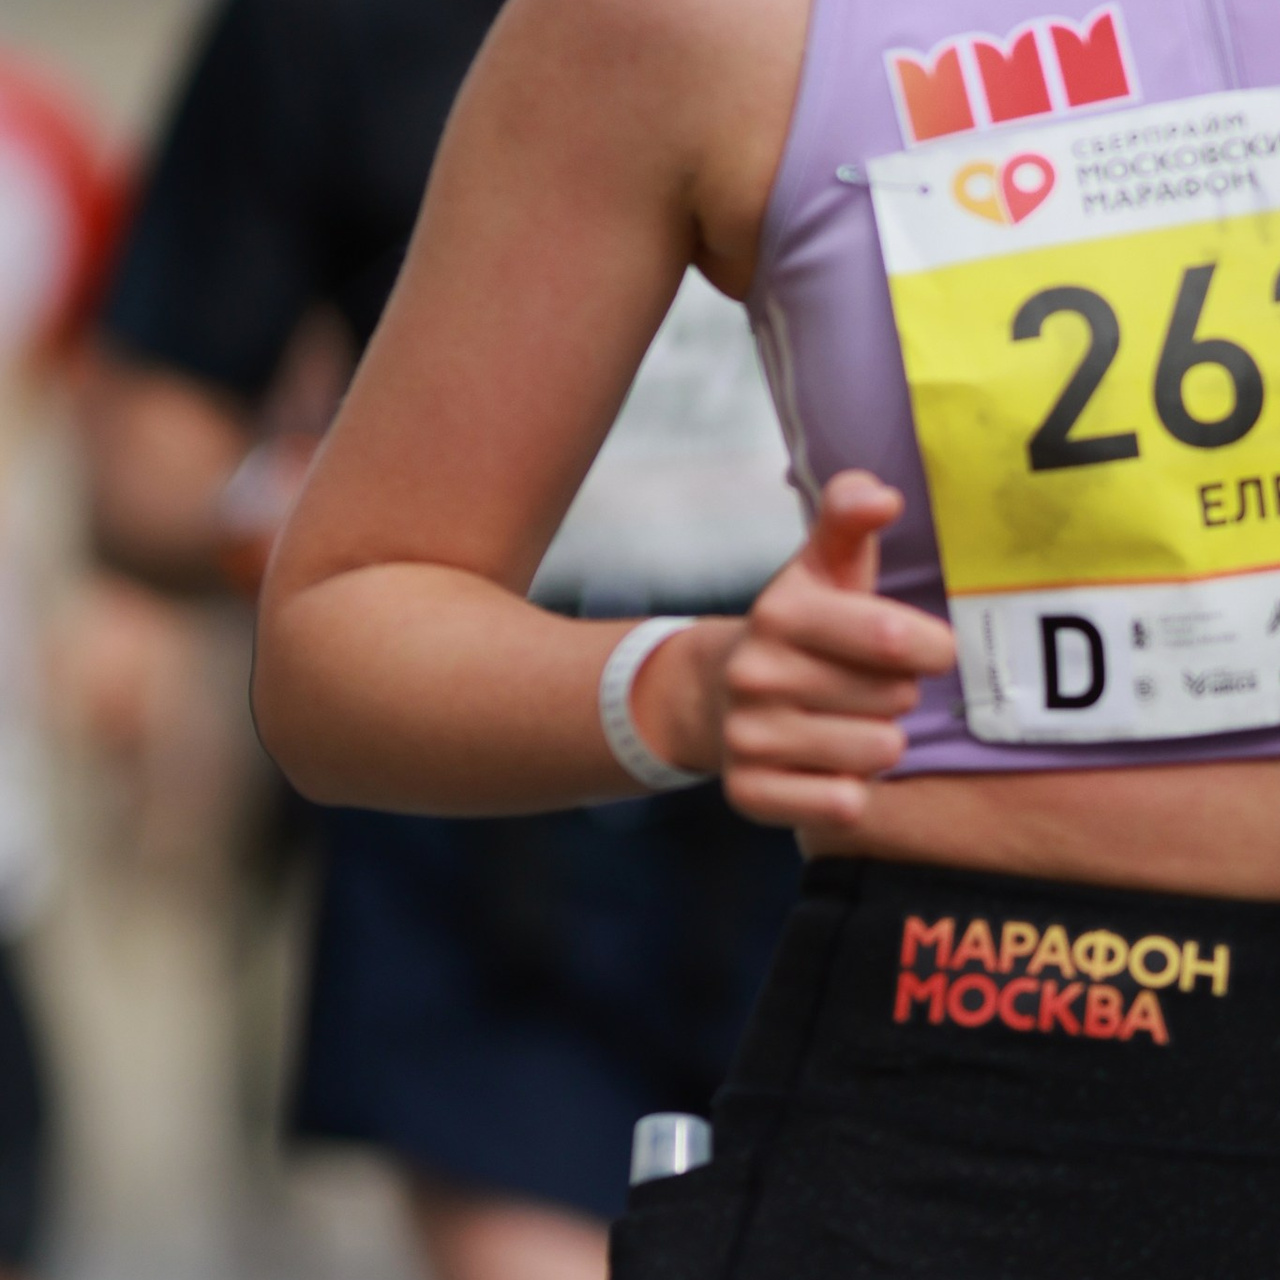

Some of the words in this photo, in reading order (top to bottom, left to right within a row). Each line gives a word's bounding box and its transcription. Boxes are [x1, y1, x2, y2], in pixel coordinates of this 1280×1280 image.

[1082, 165, 1262, 217] МАРАФОН
[1041, 615, 1106, 708] D
[901, 915, 1230, 997] МАРАФОН
[893, 972, 1169, 1045] МОСКВА
